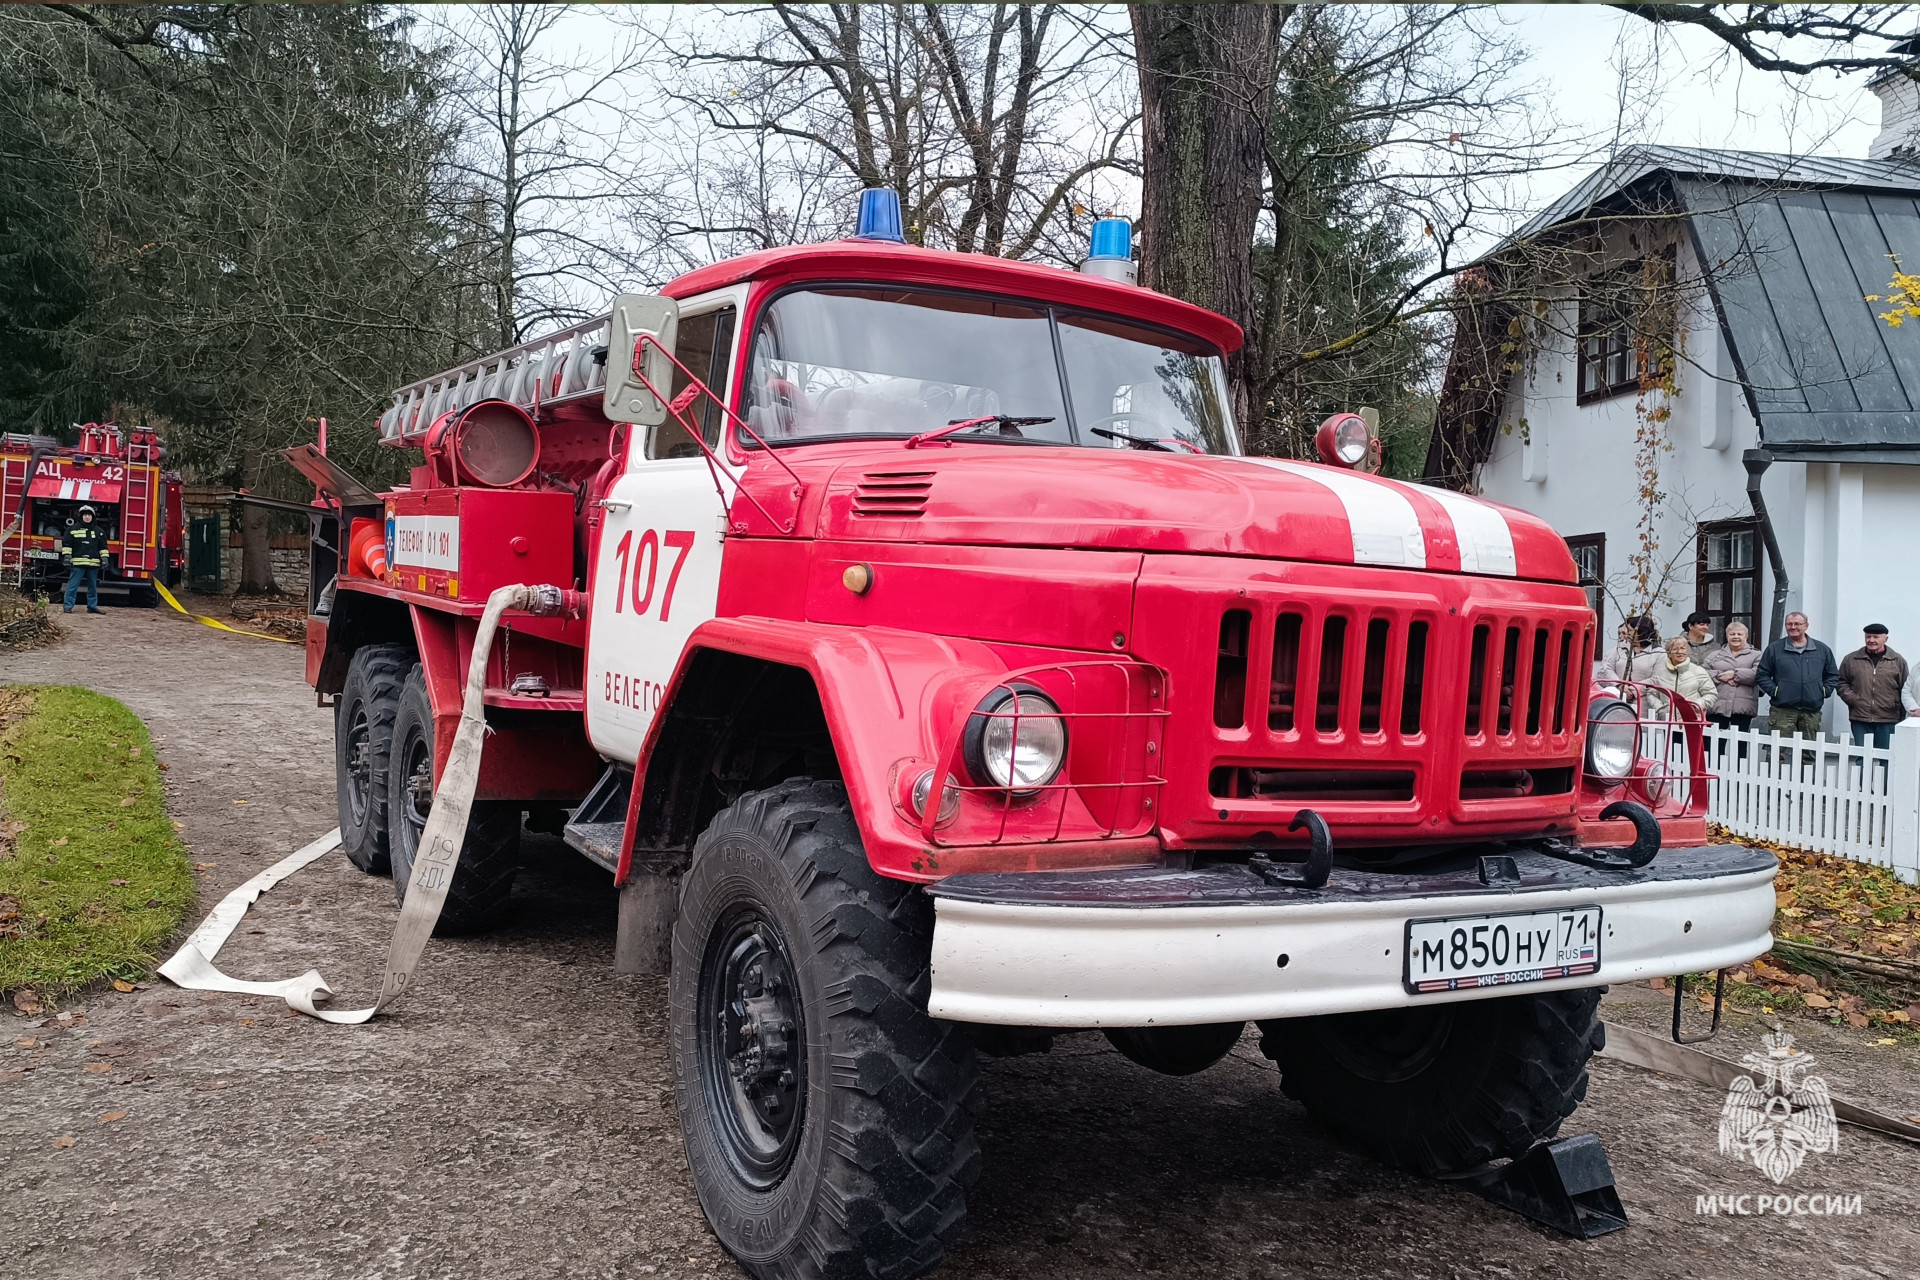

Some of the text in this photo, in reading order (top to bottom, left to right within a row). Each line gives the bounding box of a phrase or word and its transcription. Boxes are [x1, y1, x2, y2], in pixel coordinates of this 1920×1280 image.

[36, 461, 123, 480] АЦ 42
[399, 530, 423, 552] ТЕЛЕФОН
[439, 532, 449, 557] 101
[615, 528, 696, 622] 107
[605, 671, 667, 712] ВЕЛЕГО
[416, 866, 444, 890] 107
[1561, 914, 1588, 947] 71
[1558, 948, 1578, 961] RUS
[1478, 970, 1543, 986] МЧС РОССИИ
